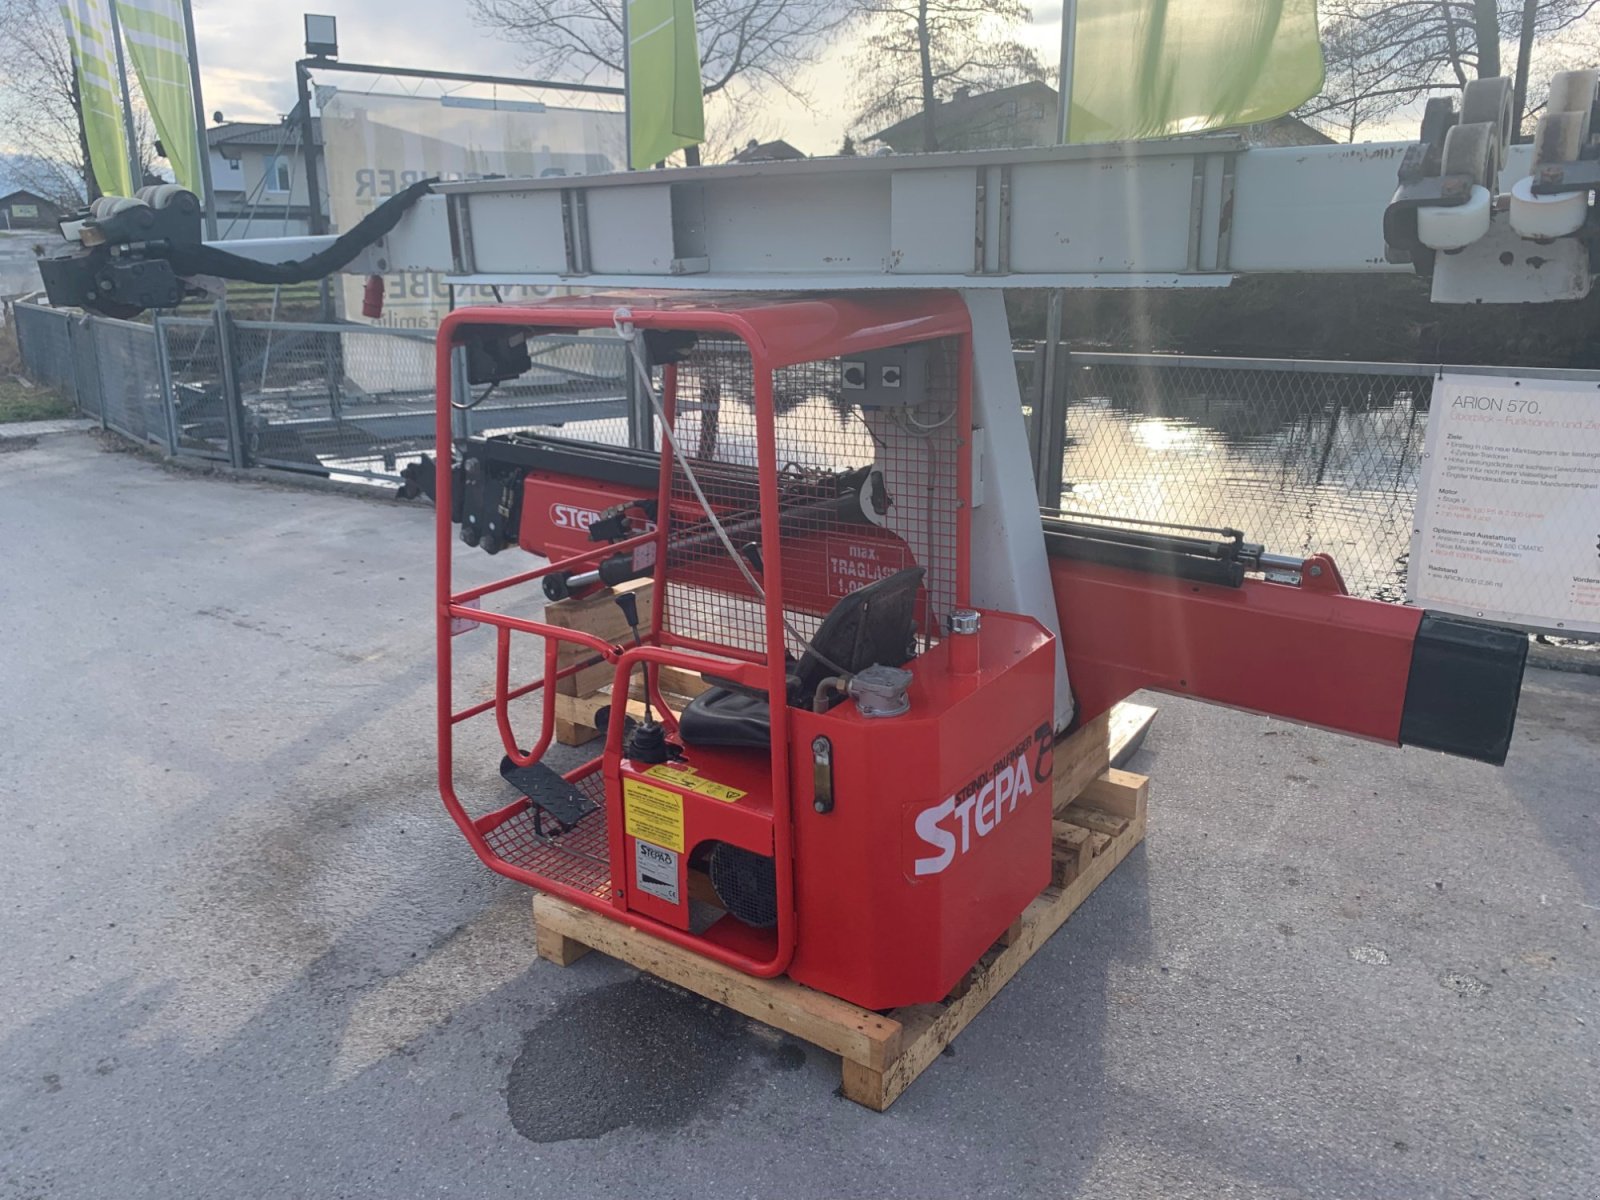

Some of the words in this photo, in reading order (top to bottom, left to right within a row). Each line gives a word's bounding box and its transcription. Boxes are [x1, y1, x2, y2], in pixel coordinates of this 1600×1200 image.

[1451, 395, 1503, 411] ARION
[1507, 399, 1543, 415] 570.
[1562, 419, 1582, 429] und
[1432, 527, 1462, 536] Optionen
[1477, 532, 1517, 543] Ausstattung
[1428, 564, 1458, 574] Radstand
[1444, 574, 1464, 582] ARION
[914, 752, 1033, 876] STEPA
